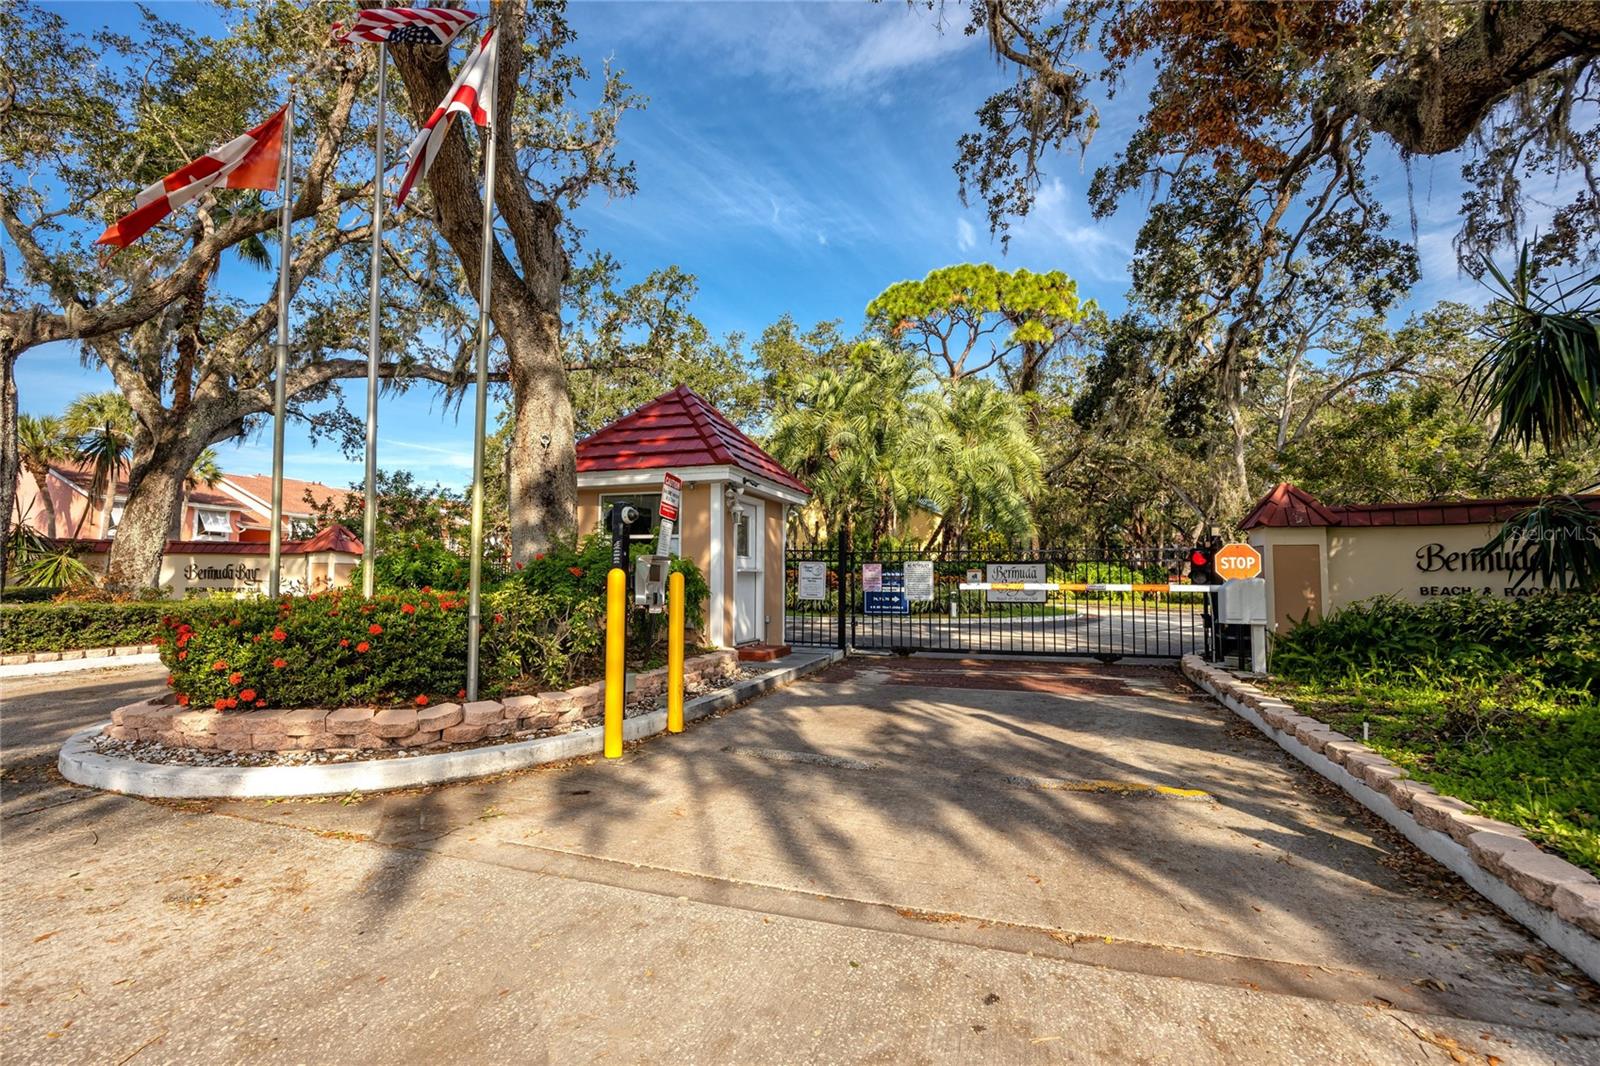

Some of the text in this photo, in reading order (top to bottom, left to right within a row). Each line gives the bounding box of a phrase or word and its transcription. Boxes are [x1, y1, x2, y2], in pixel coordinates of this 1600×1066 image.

[1220, 556, 1256, 570] STOP
[184, 563, 262, 586] Bermuda Bay
[991, 565, 1038, 581] Bermuda
[1419, 586, 1472, 597] BEACH
